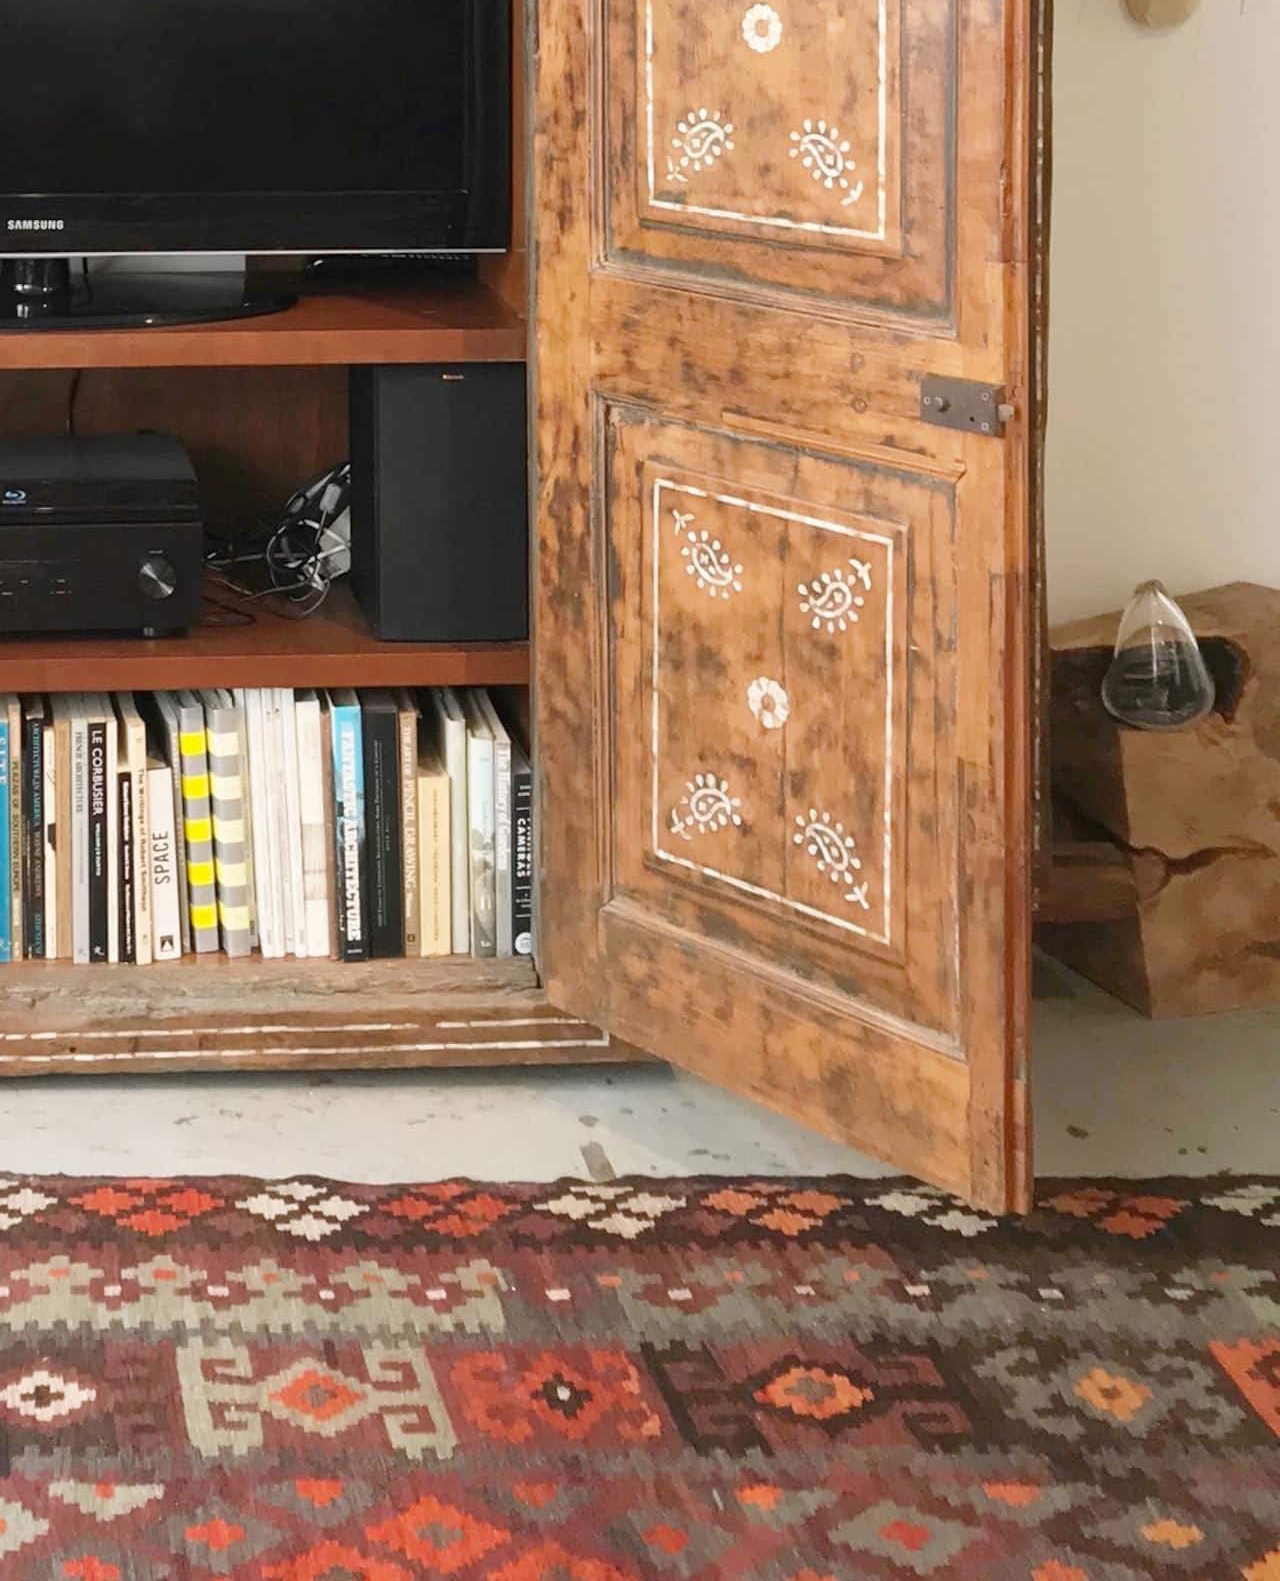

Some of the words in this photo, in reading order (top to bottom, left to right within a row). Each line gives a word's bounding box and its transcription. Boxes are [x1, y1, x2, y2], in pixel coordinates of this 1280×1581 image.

[7, 219, 64, 230] SAMSUNG
[31, 722, 40, 778] ARCHITECTURE
[91, 730, 102, 743] LE
[403, 725, 411, 740] THE
[404, 743, 412, 761] ART
[340, 730, 357, 817] FANTASTIC
[497, 748, 509, 768] The
[91, 747, 103, 815] CORBUSIER
[11, 799, 18, 808] OF
[32, 791, 41, 826] AMERICA
[136, 787, 145, 823] Writings
[403, 780, 415, 822] PENCIL
[155, 831, 171, 885] SPACE
[404, 827, 416, 887] DRAWING
[516, 817, 526, 877] CAMERAS
[343, 818, 361, 940] ARCHITECTURE
